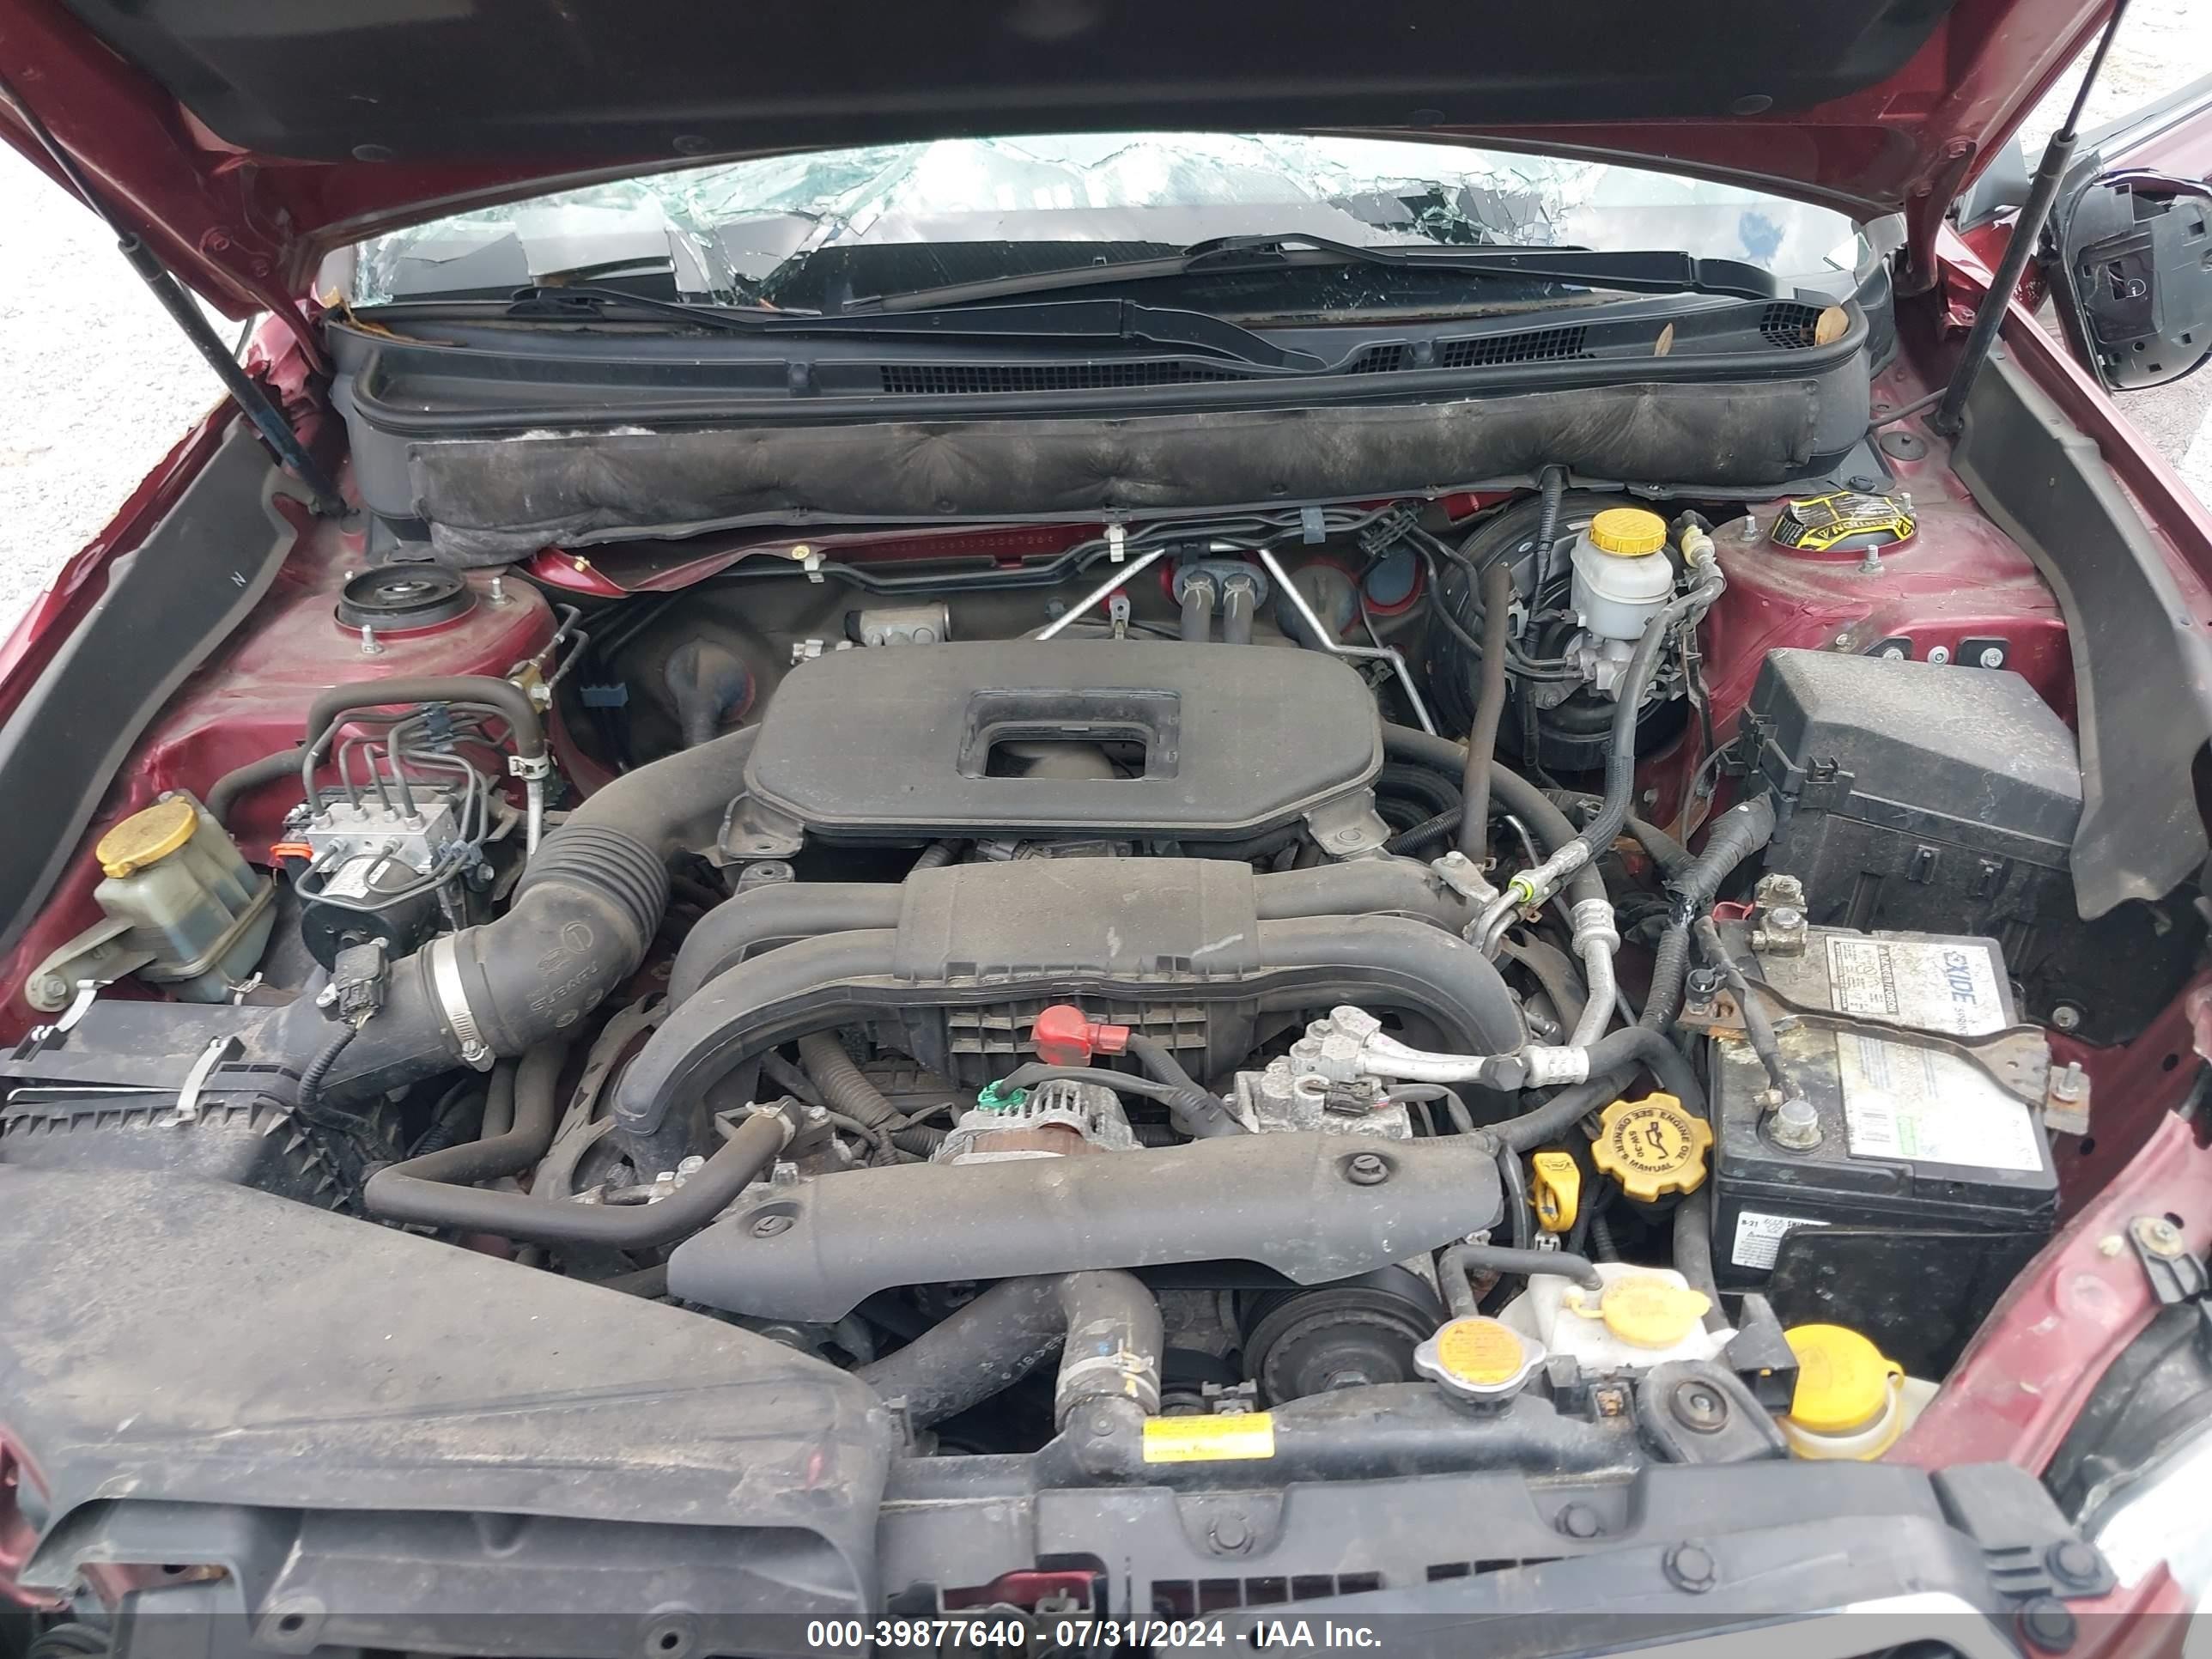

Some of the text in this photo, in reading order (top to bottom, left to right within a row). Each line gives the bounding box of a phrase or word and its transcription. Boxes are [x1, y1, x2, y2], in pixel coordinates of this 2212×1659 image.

[1944, 951, 1978, 1005] EXIDE
[1632, 1109, 1654, 1120] SEE
[1659, 1111, 1691, 1160] ENGINE OIL
[1629, 1159, 1674, 1172] MANUAL
